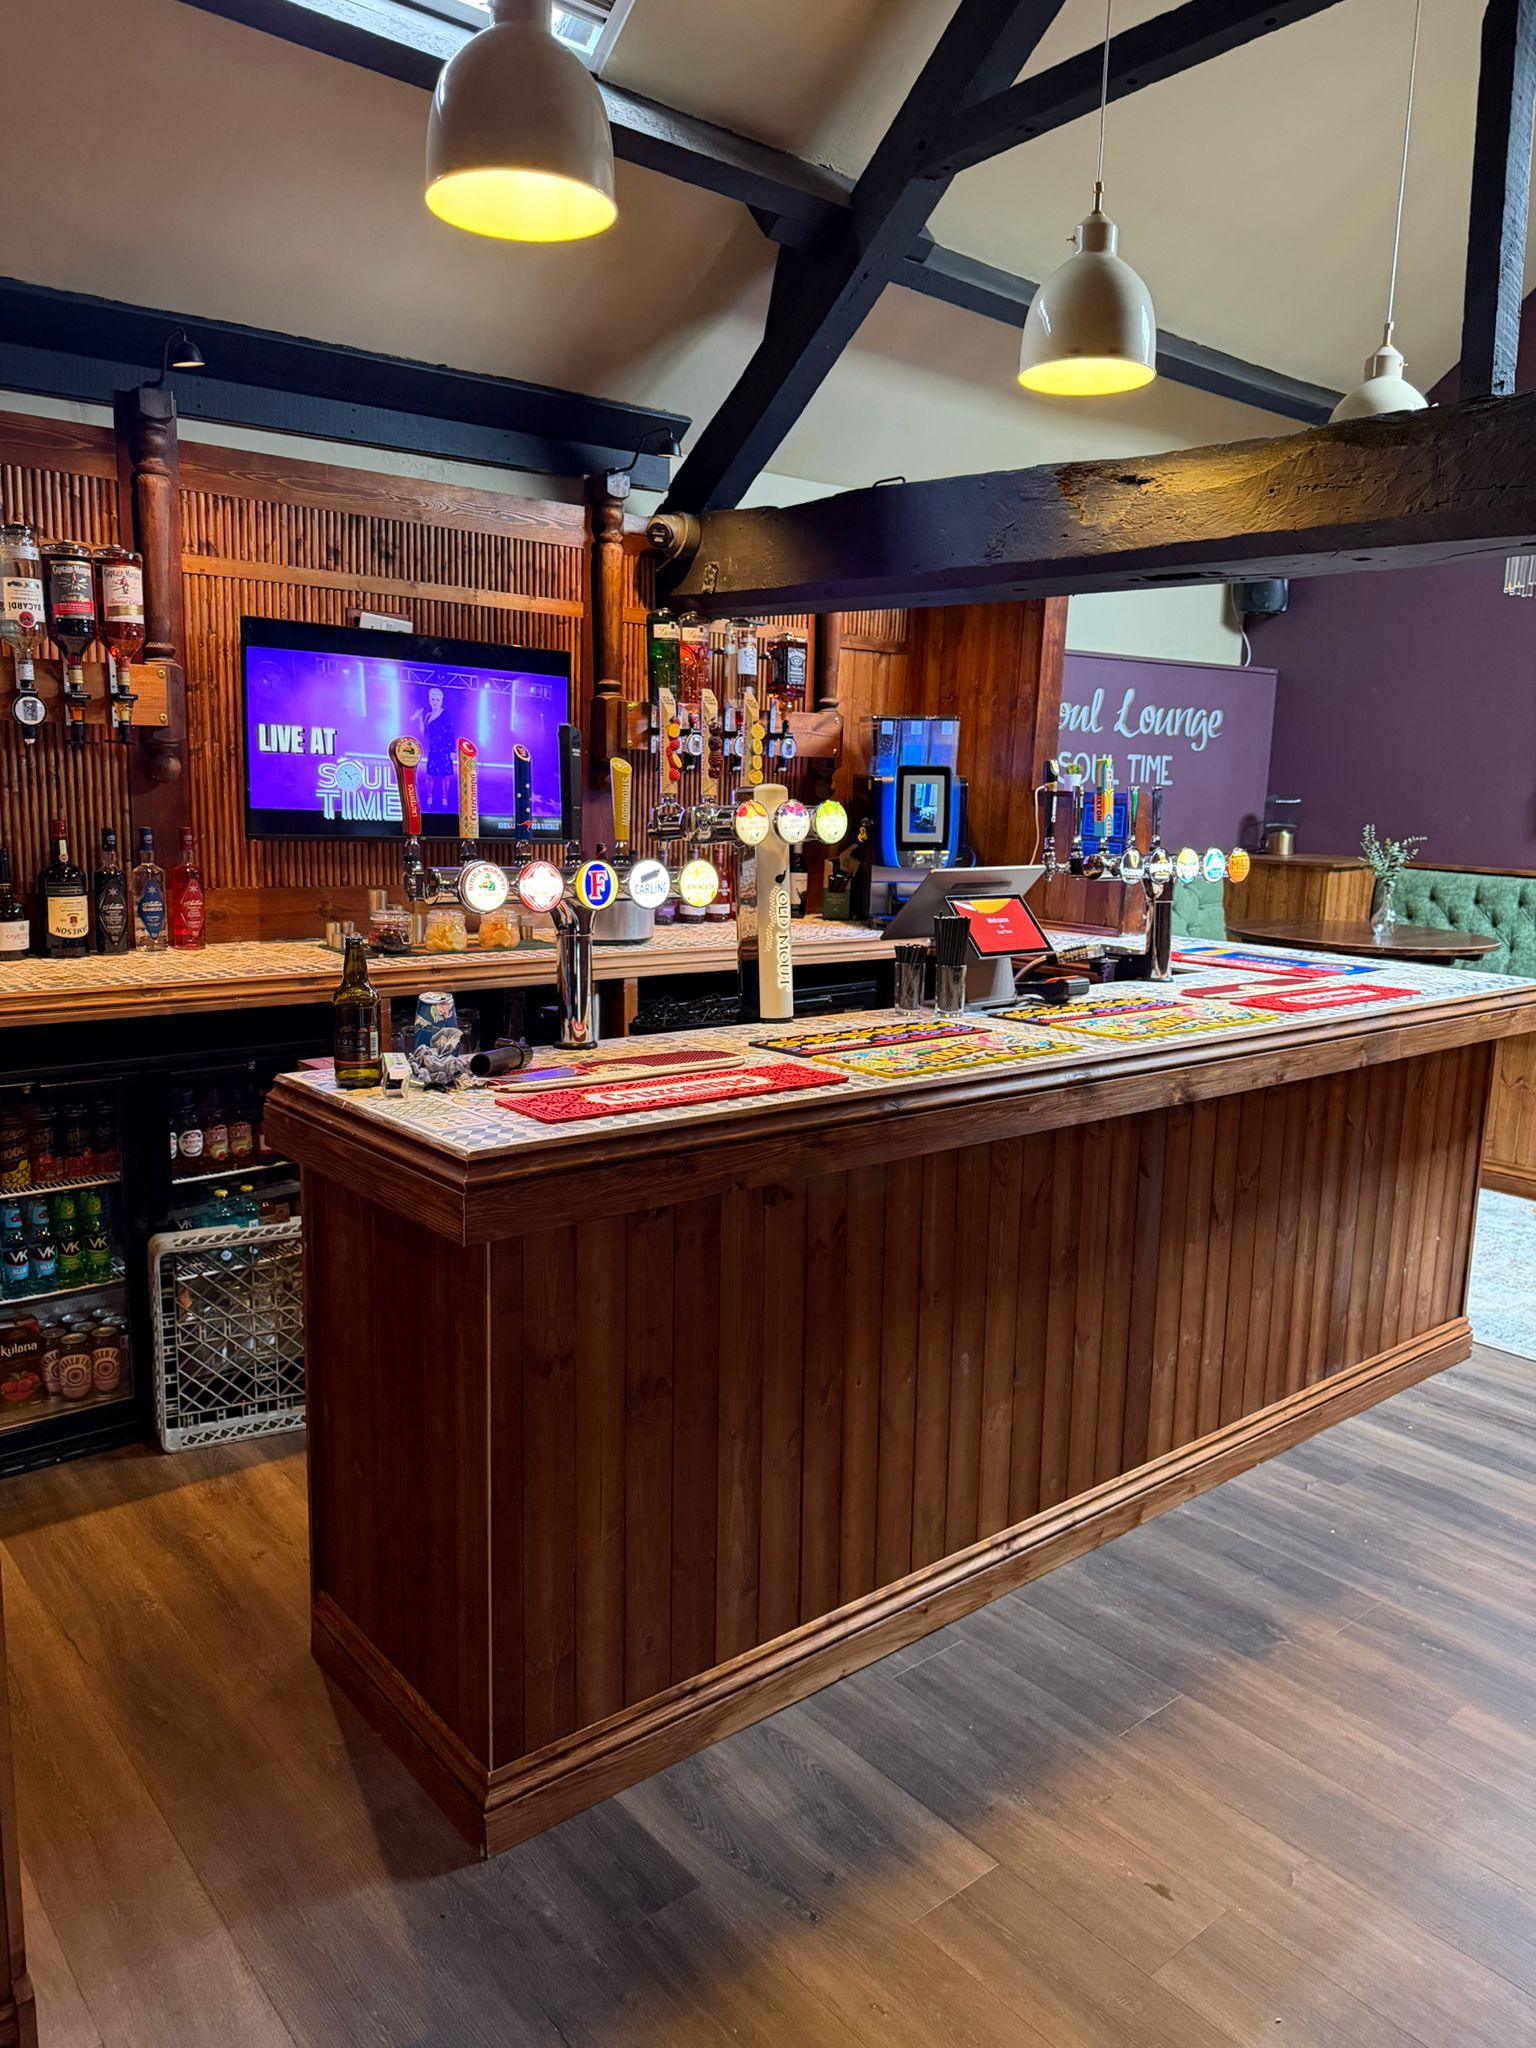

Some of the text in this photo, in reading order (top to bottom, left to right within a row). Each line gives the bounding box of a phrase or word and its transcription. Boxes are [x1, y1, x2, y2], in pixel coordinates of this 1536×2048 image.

[1059, 688, 1224, 751] oul Lounge
[258, 723, 337, 756] LIVE AT
[1127, 754, 1173, 786] TIME
[315, 789, 403, 822] TIME
[470, 773, 478, 822] Cruzcampo
[621, 776, 631, 828] STRONGBOW
[588, 870, 608, 900] F
[778, 892, 789, 928] OLD
[55, 925, 88, 936] JAMESON
[599, 1076, 757, 1102] Cruzcampo
[10, 1249, 28, 1264] VK
[38, 1244, 55, 1259] VK
[61, 1241, 80, 1255] VK
[89, 1236, 108, 1250] VK
